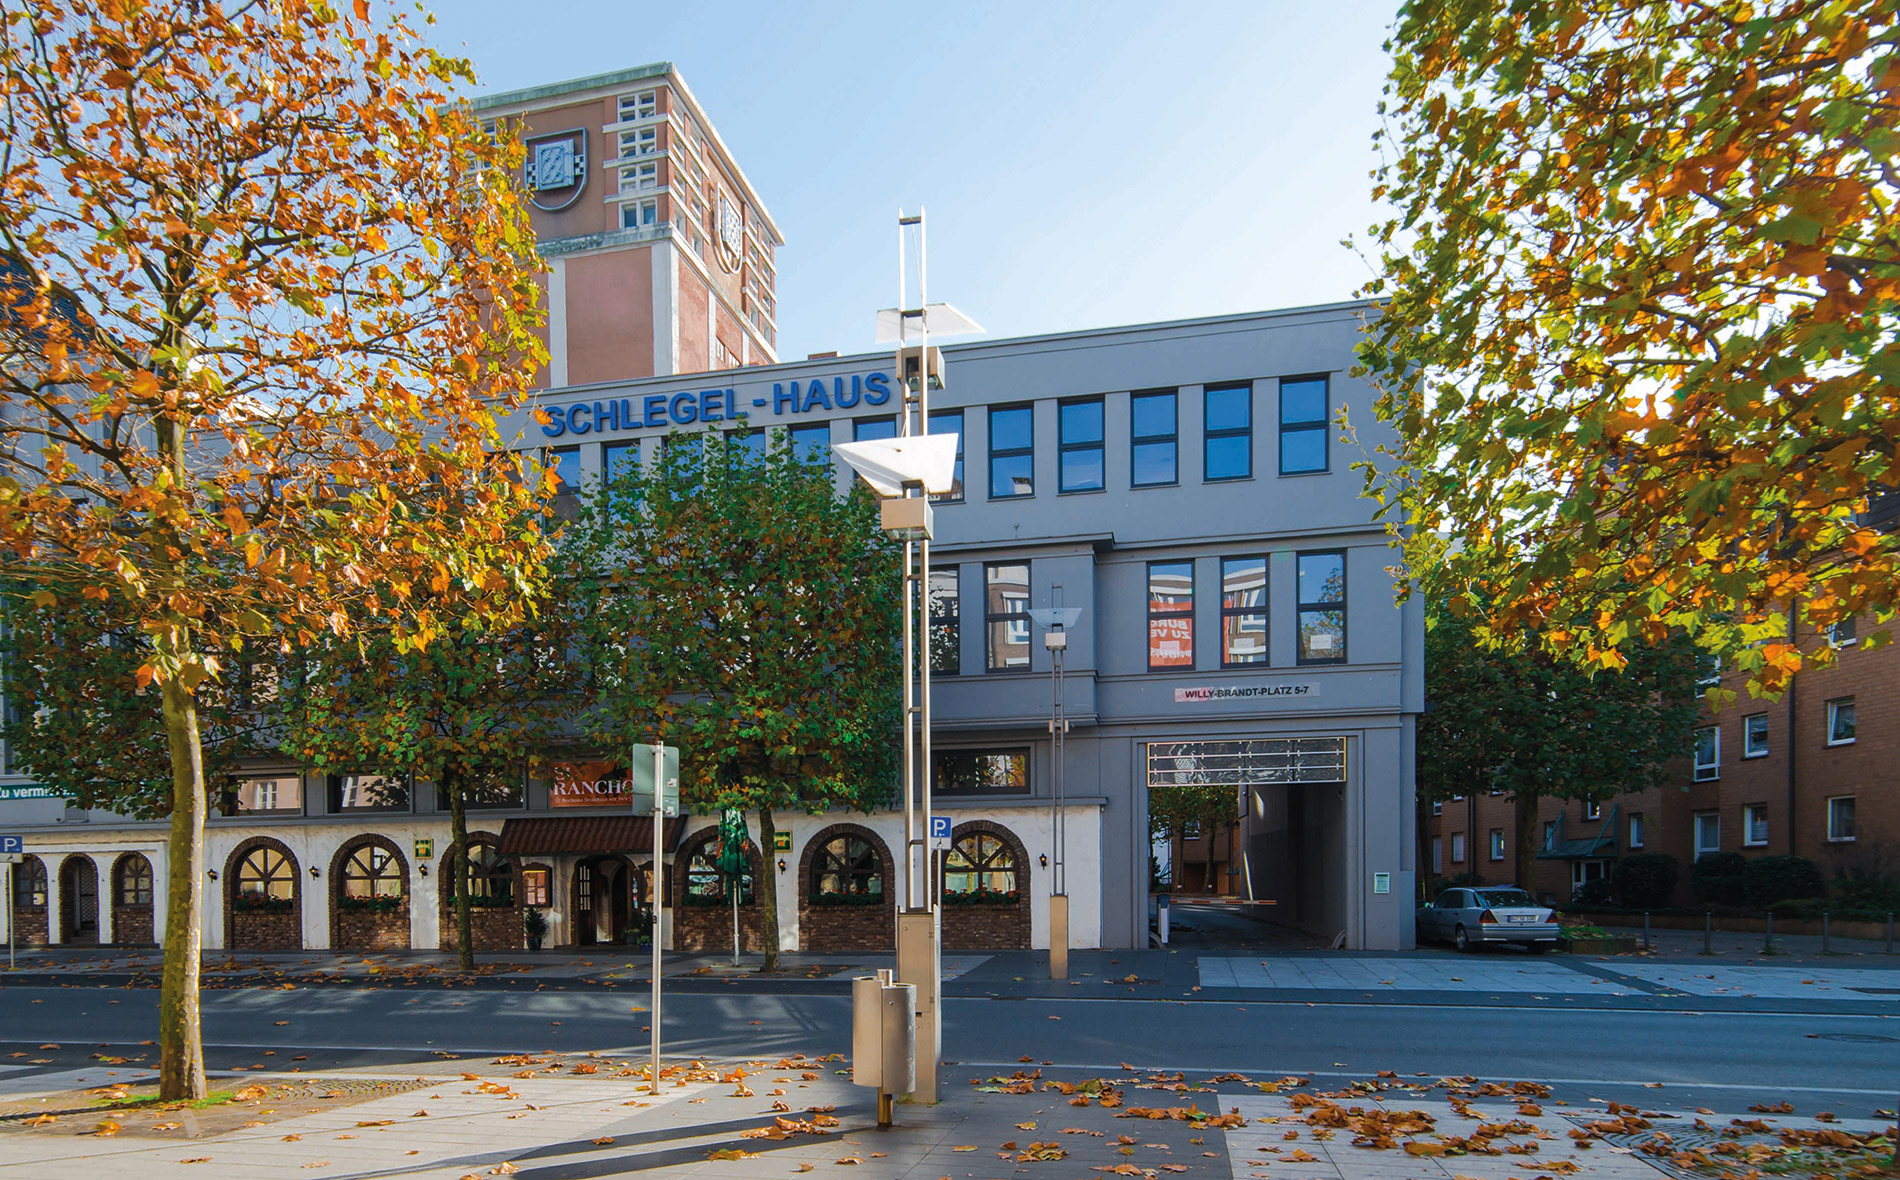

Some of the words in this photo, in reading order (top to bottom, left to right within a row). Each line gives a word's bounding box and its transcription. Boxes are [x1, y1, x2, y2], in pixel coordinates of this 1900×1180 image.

[1185, 686, 1292, 698] WILLY-BRANDT-PLATZ
[1294, 686, 1310, 695] 5-7
[934, 819, 946, 836] P
[4, 837, 18, 852] P
